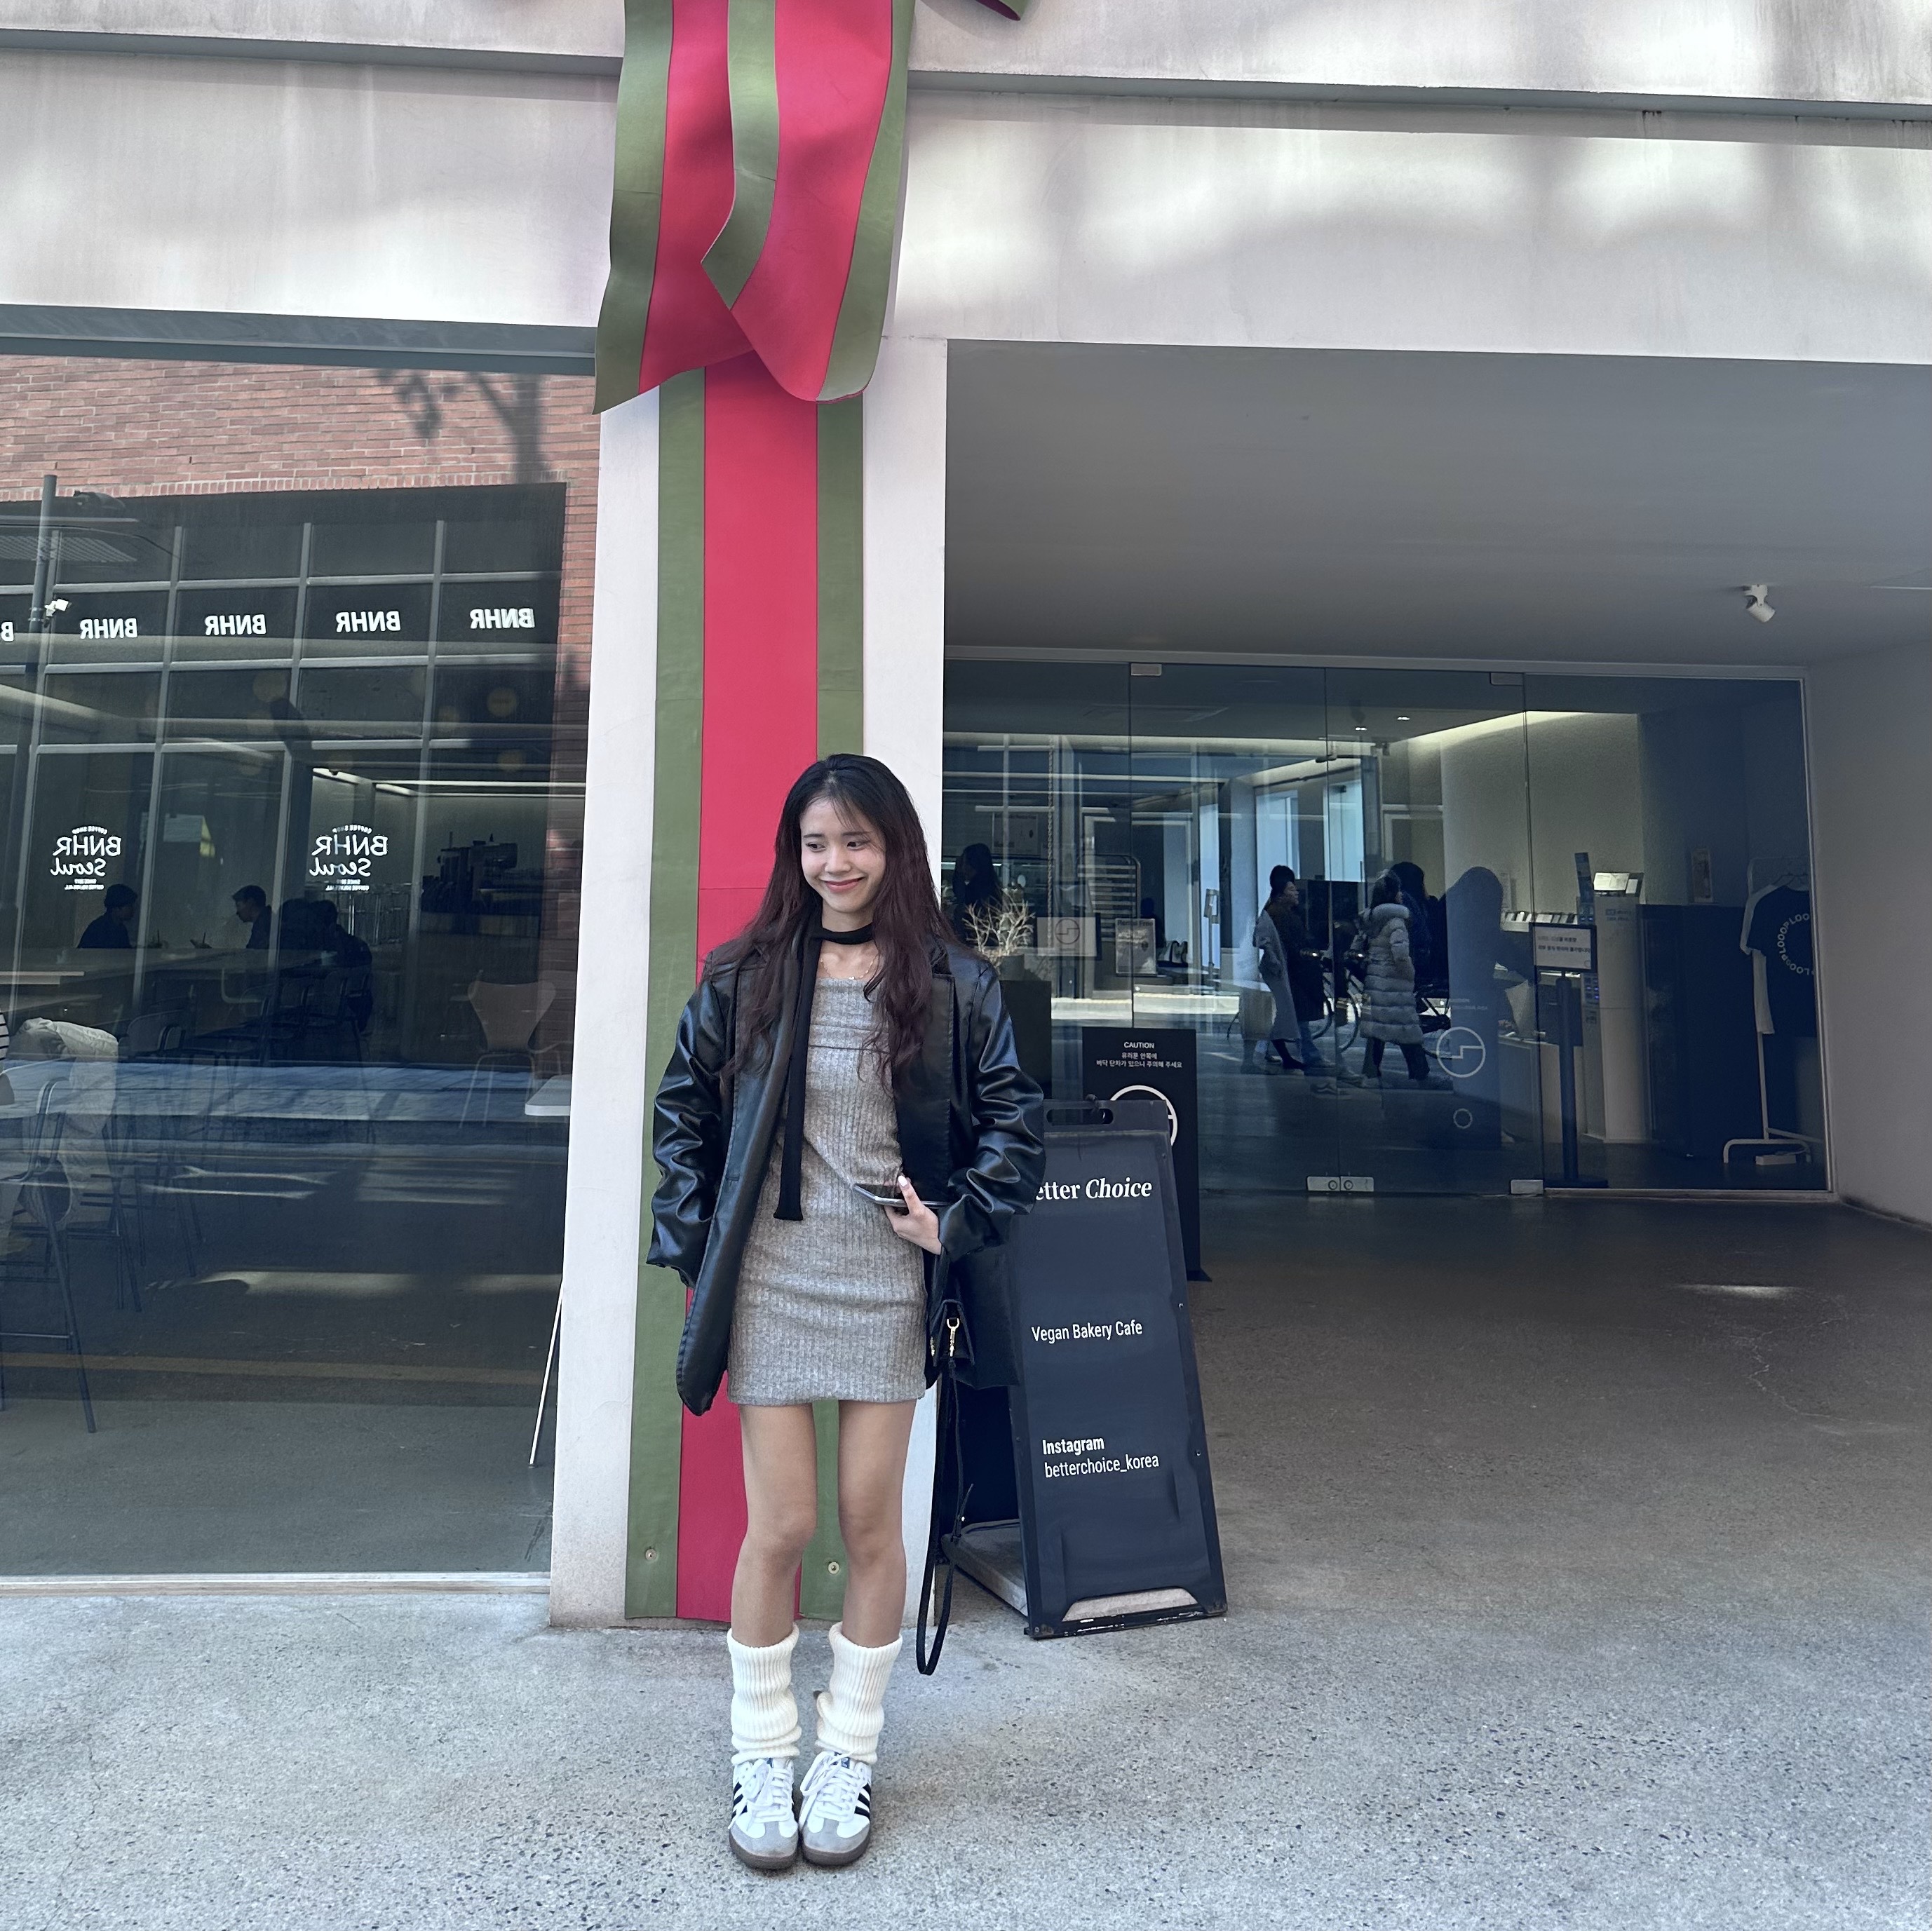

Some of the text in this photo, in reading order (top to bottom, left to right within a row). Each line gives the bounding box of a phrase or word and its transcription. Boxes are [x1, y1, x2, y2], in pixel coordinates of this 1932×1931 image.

[1035, 1177, 1153, 1201] etter Choice
[1031, 1319, 1143, 1344] Vegan Bakery Cafe
[1042, 1437, 1105, 1456] Instagram
[1044, 1454, 1159, 1478] betterchoice_korea
